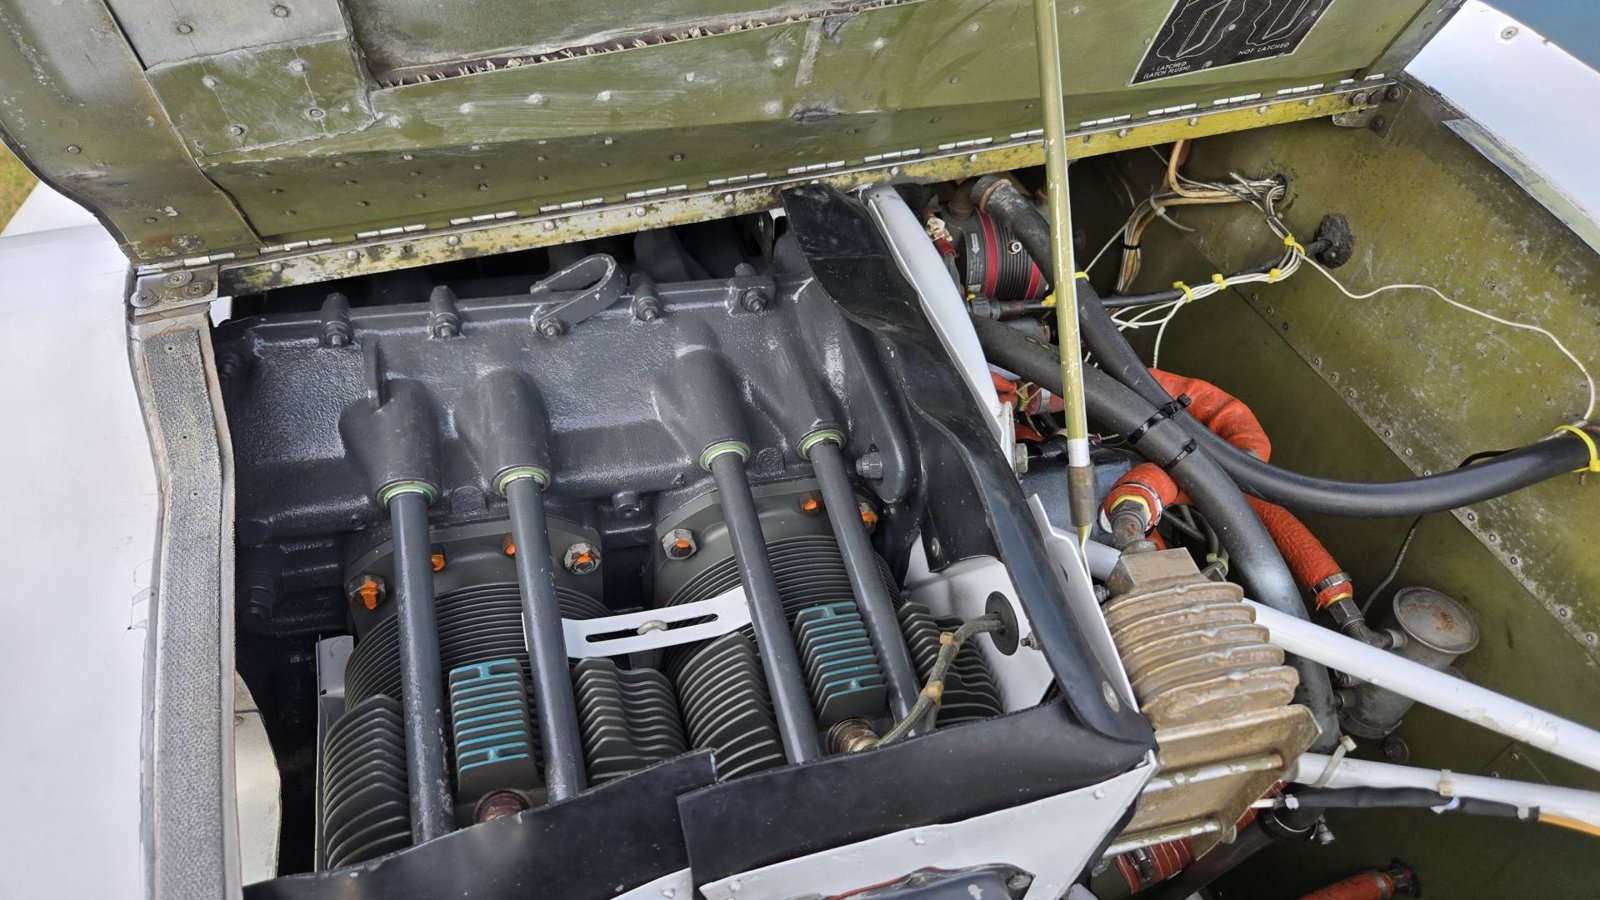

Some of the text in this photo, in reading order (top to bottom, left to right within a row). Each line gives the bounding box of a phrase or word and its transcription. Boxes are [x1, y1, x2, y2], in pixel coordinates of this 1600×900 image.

[1237, 42, 1290, 56] NOT LATCHED
[1157, 61, 1187, 71] LATCHED
